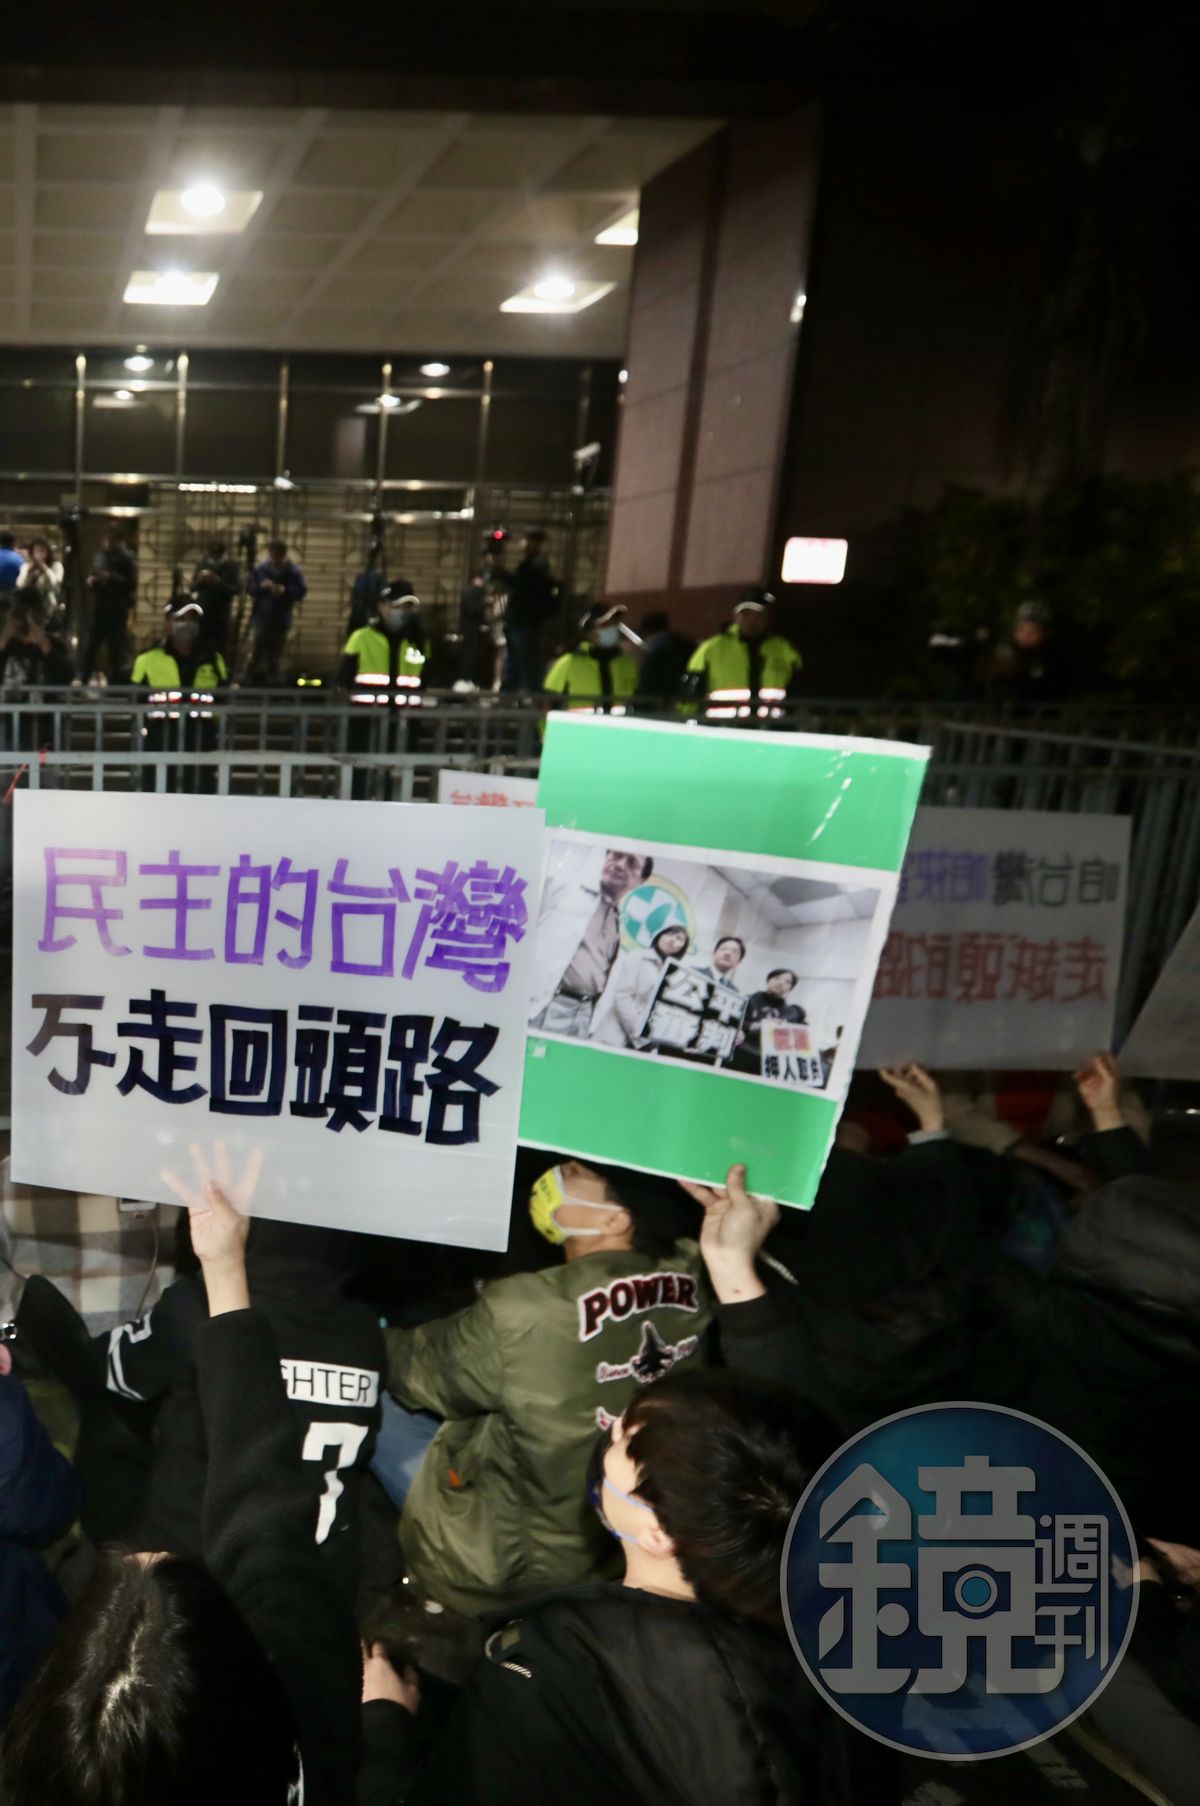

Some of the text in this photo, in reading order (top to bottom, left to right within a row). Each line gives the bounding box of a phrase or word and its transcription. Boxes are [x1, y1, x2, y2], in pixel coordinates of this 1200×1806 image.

[37, 847, 529, 994] 民主的台灣
[26, 988, 503, 1146] 不走回頭路
[580, 1273, 698, 1340] POWER
[280, 1364, 372, 1403] HTER
[302, 1422, 368, 1545] 7
